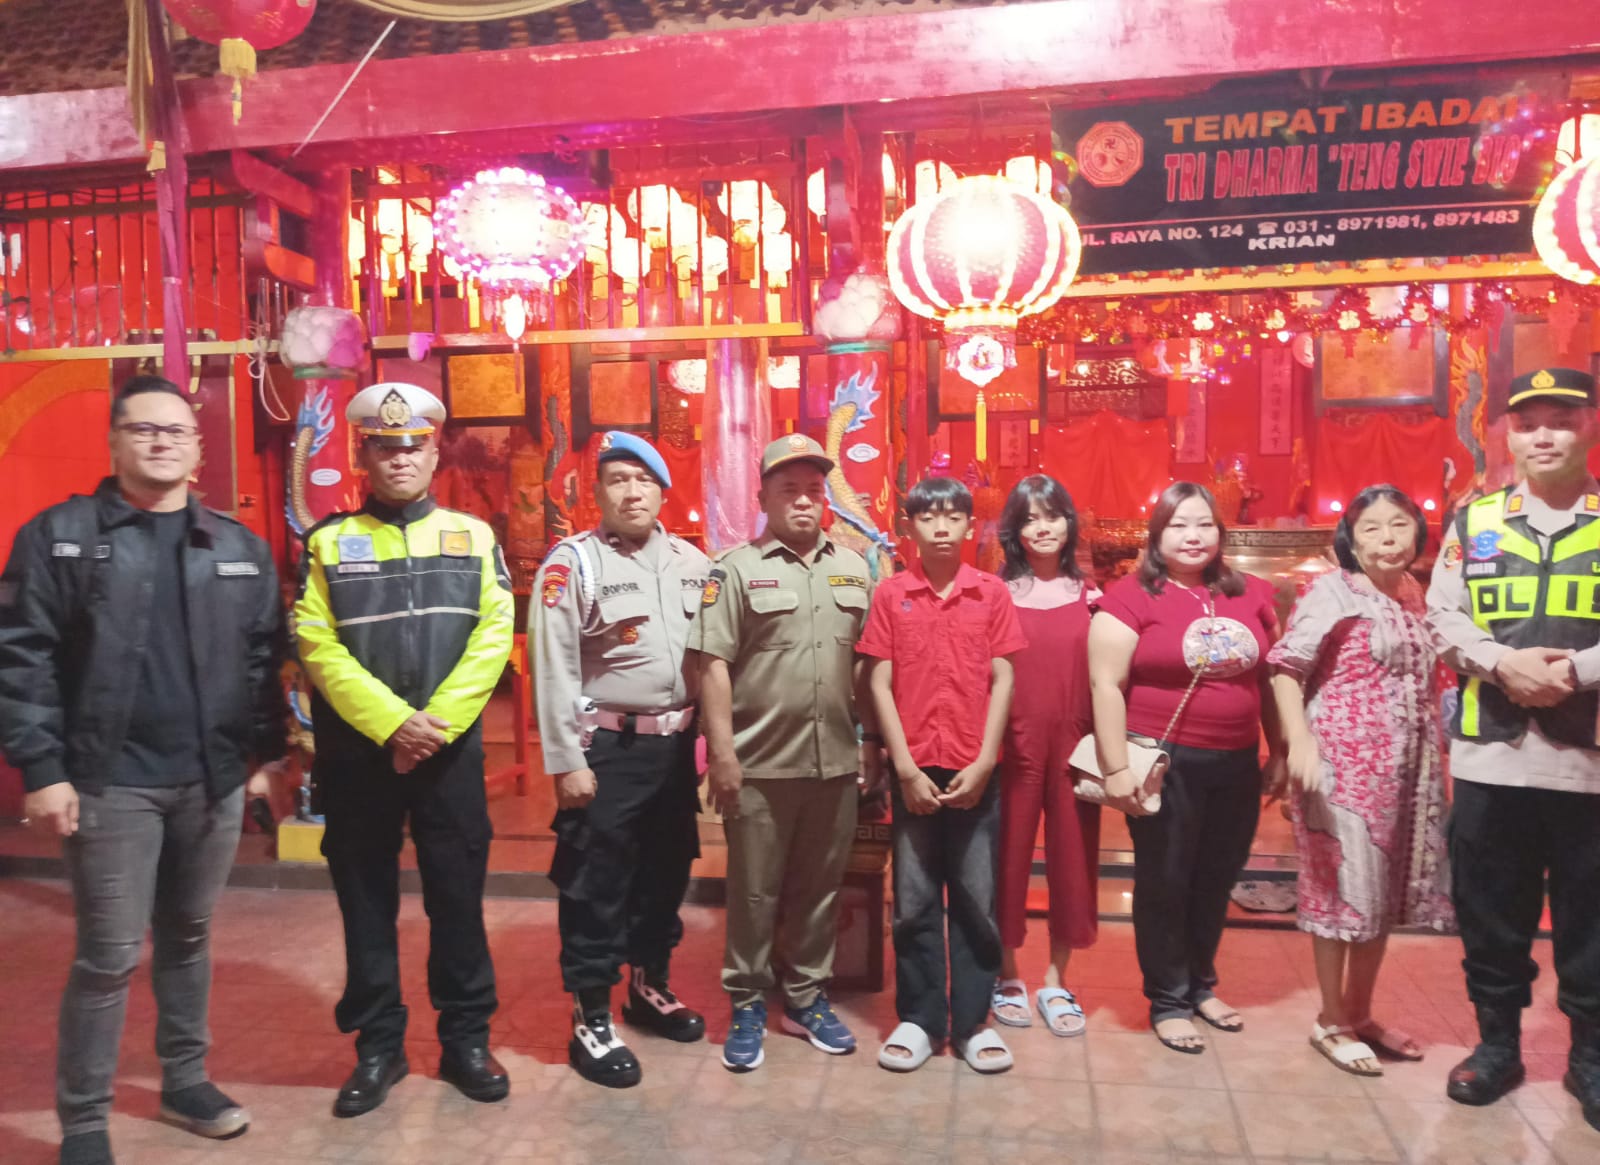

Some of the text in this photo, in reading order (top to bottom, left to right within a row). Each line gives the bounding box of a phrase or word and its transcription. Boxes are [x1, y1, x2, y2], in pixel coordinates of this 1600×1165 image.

[1164, 106, 1347, 144] TEMPAT
[1164, 152, 1206, 202] TRI
[1213, 144, 1318, 199] DHARMA
[1404, 137, 1471, 189] SWIE
[1110, 228, 1163, 245] RAYA
[1168, 226, 1202, 241] NO.
[1209, 224, 1244, 239] 124
[1284, 219, 1318, 234] 031
[1433, 209, 1520, 228] 8971483
[1248, 234, 1336, 251] KRIAN
